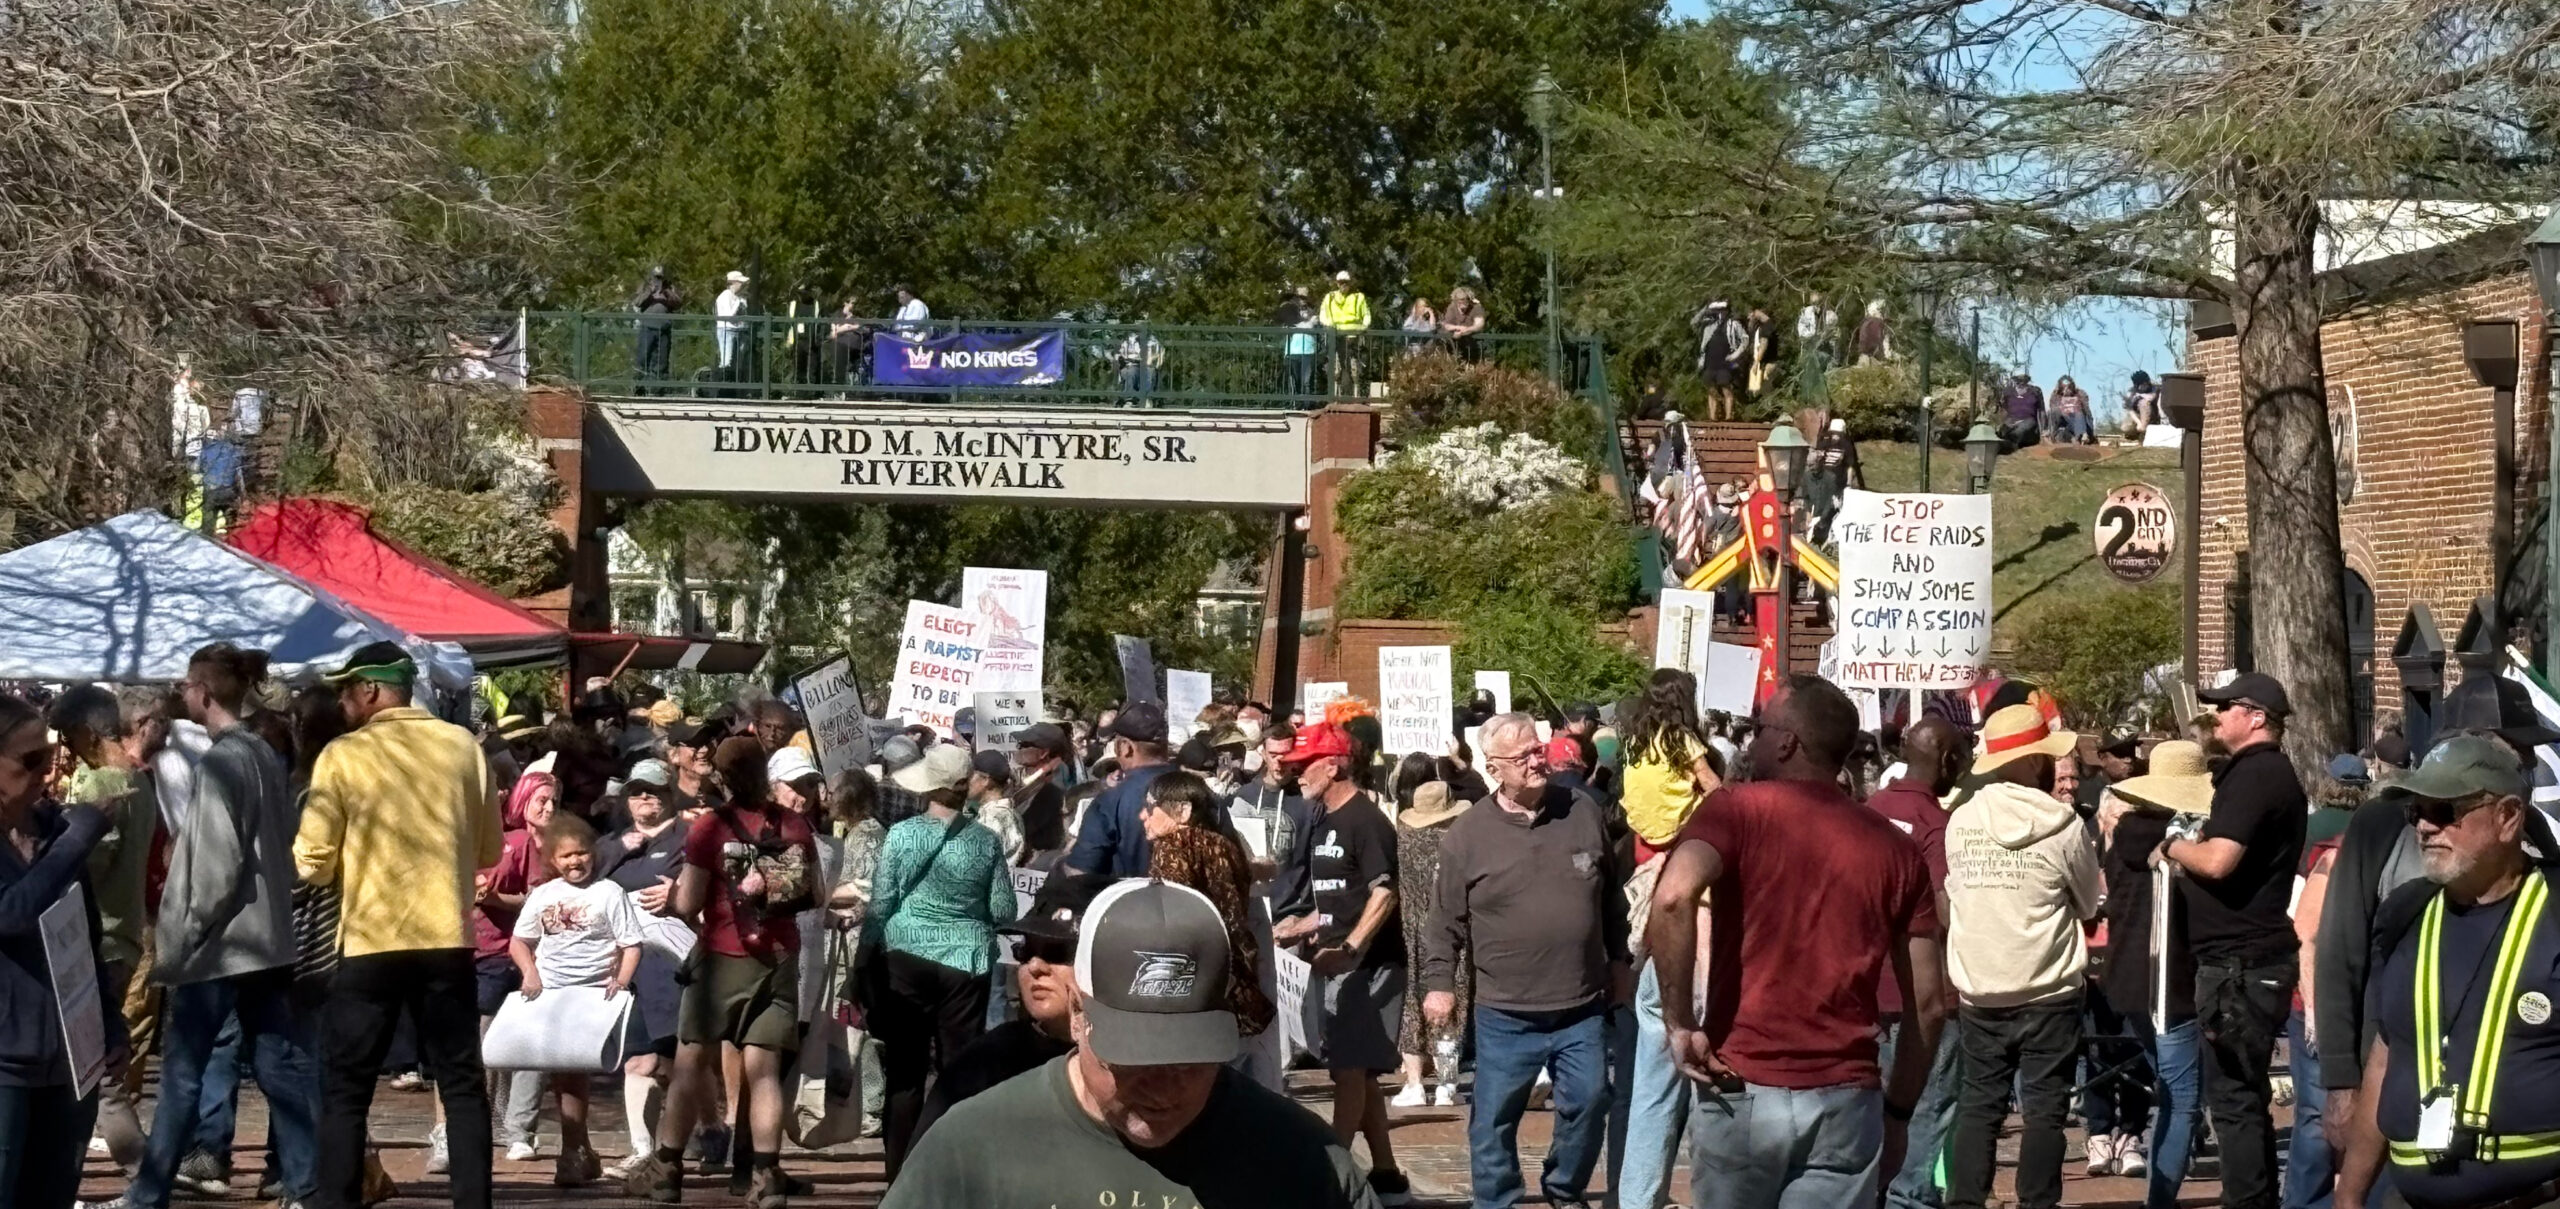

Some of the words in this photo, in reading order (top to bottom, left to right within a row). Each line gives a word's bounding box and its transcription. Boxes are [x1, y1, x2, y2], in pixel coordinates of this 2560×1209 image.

[941, 351, 971, 368] NO
[974, 351, 1038, 368] KINGS
[713, 426, 873, 454] EDWARD
[881, 428, 923, 456] M.
[933, 429, 1132, 465] McINTYRE,
[1142, 435, 1198, 462] SR.
[841, 459, 1066, 489] RIVERWALK
[1881, 498, 1944, 520] STOP
[1842, 522, 1876, 543] THE
[1883, 523, 1921, 544] ICE
[1929, 525, 1986, 547] RAIDS
[2137, 527, 2165, 540] CITY
[1892, 552, 1935, 574] AND
[1854, 578, 1913, 601] SHOW
[1919, 579, 1975, 602] SOME
[923, 614, 976, 637] ELECT
[905, 635, 917, 650] A
[1419, 650, 1442, 668] NOT
[909, 660, 975, 686] EXPECT
[1842, 661, 1935, 682] MATTHEW
[911, 683, 933, 701] TO
[938, 688, 962, 707] BE
[1416, 695, 1441, 713] JUST
[1389, 730, 1441, 751] HISTORY
